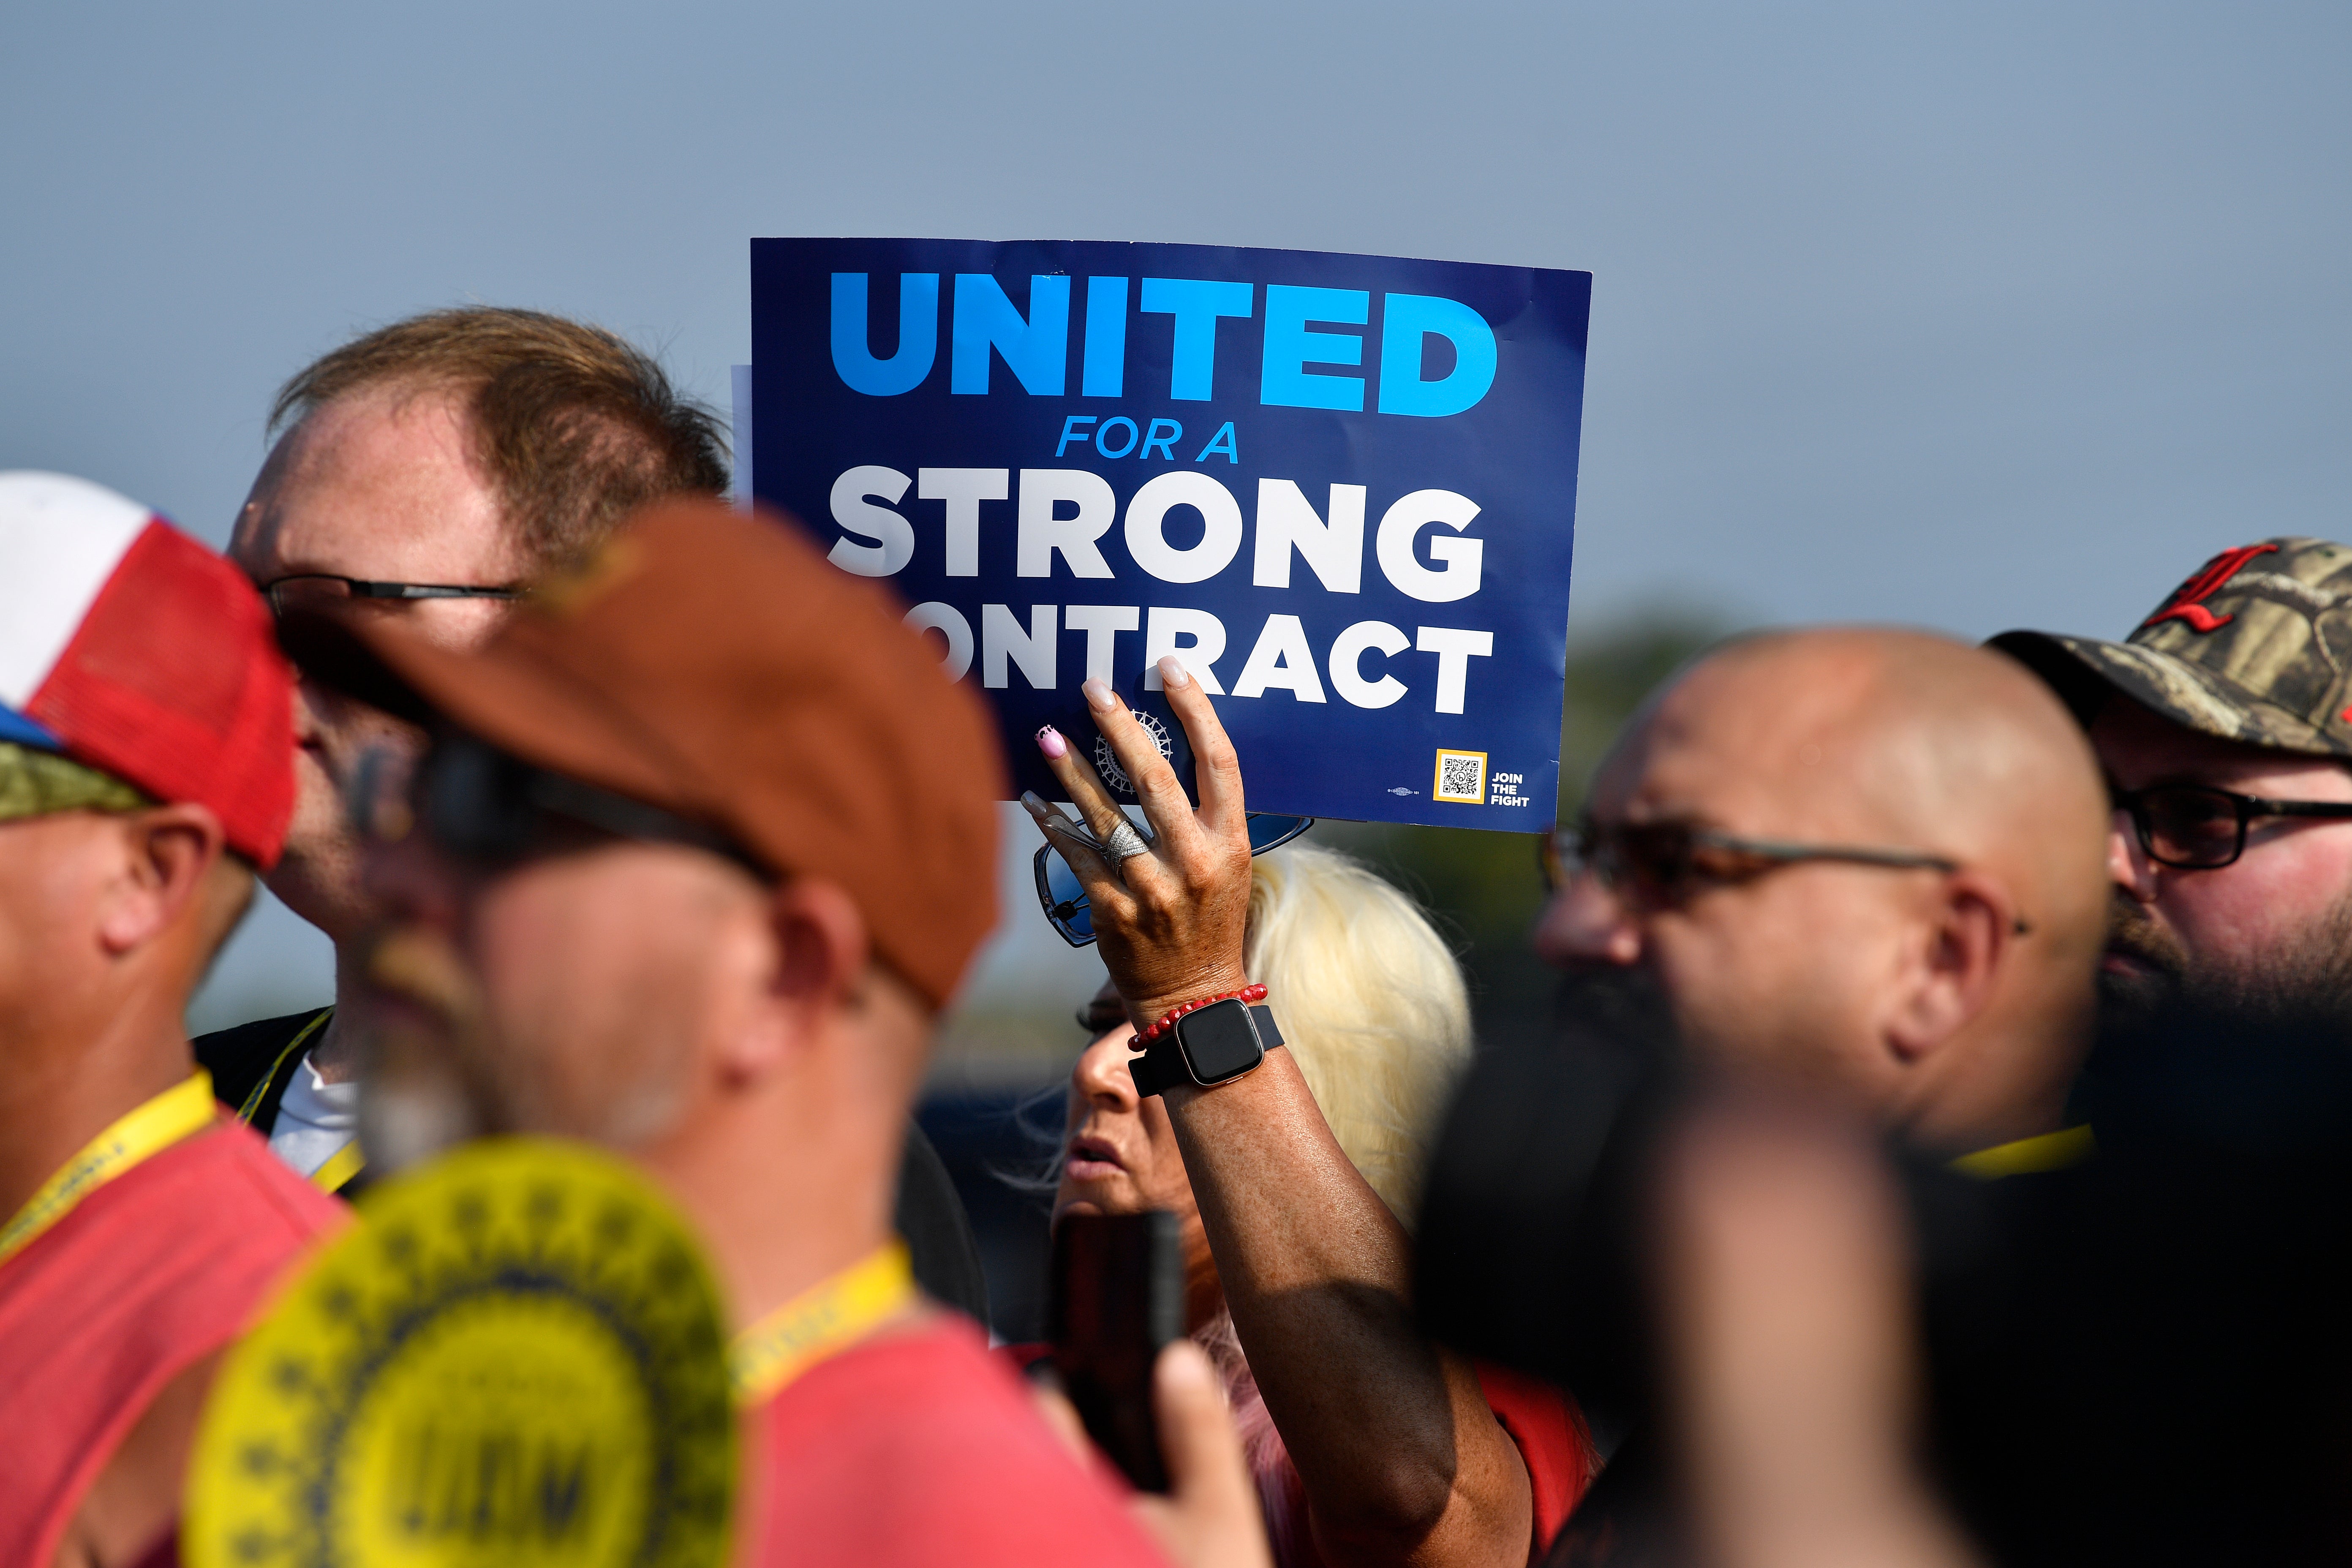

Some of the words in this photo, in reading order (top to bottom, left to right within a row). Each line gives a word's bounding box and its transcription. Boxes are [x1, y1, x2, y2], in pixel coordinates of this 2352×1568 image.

[830, 272, 1498, 417] UNITED
[1055, 415, 1183, 460] FOR
[1195, 421, 1239, 464] A
[828, 465, 1484, 603] STRONG
[900, 601, 1494, 715] ONTRACT
[1491, 795, 1530, 807] FIGHT
[1492, 772, 1523, 784] JOIN
[1492, 783, 1517, 795] THE
